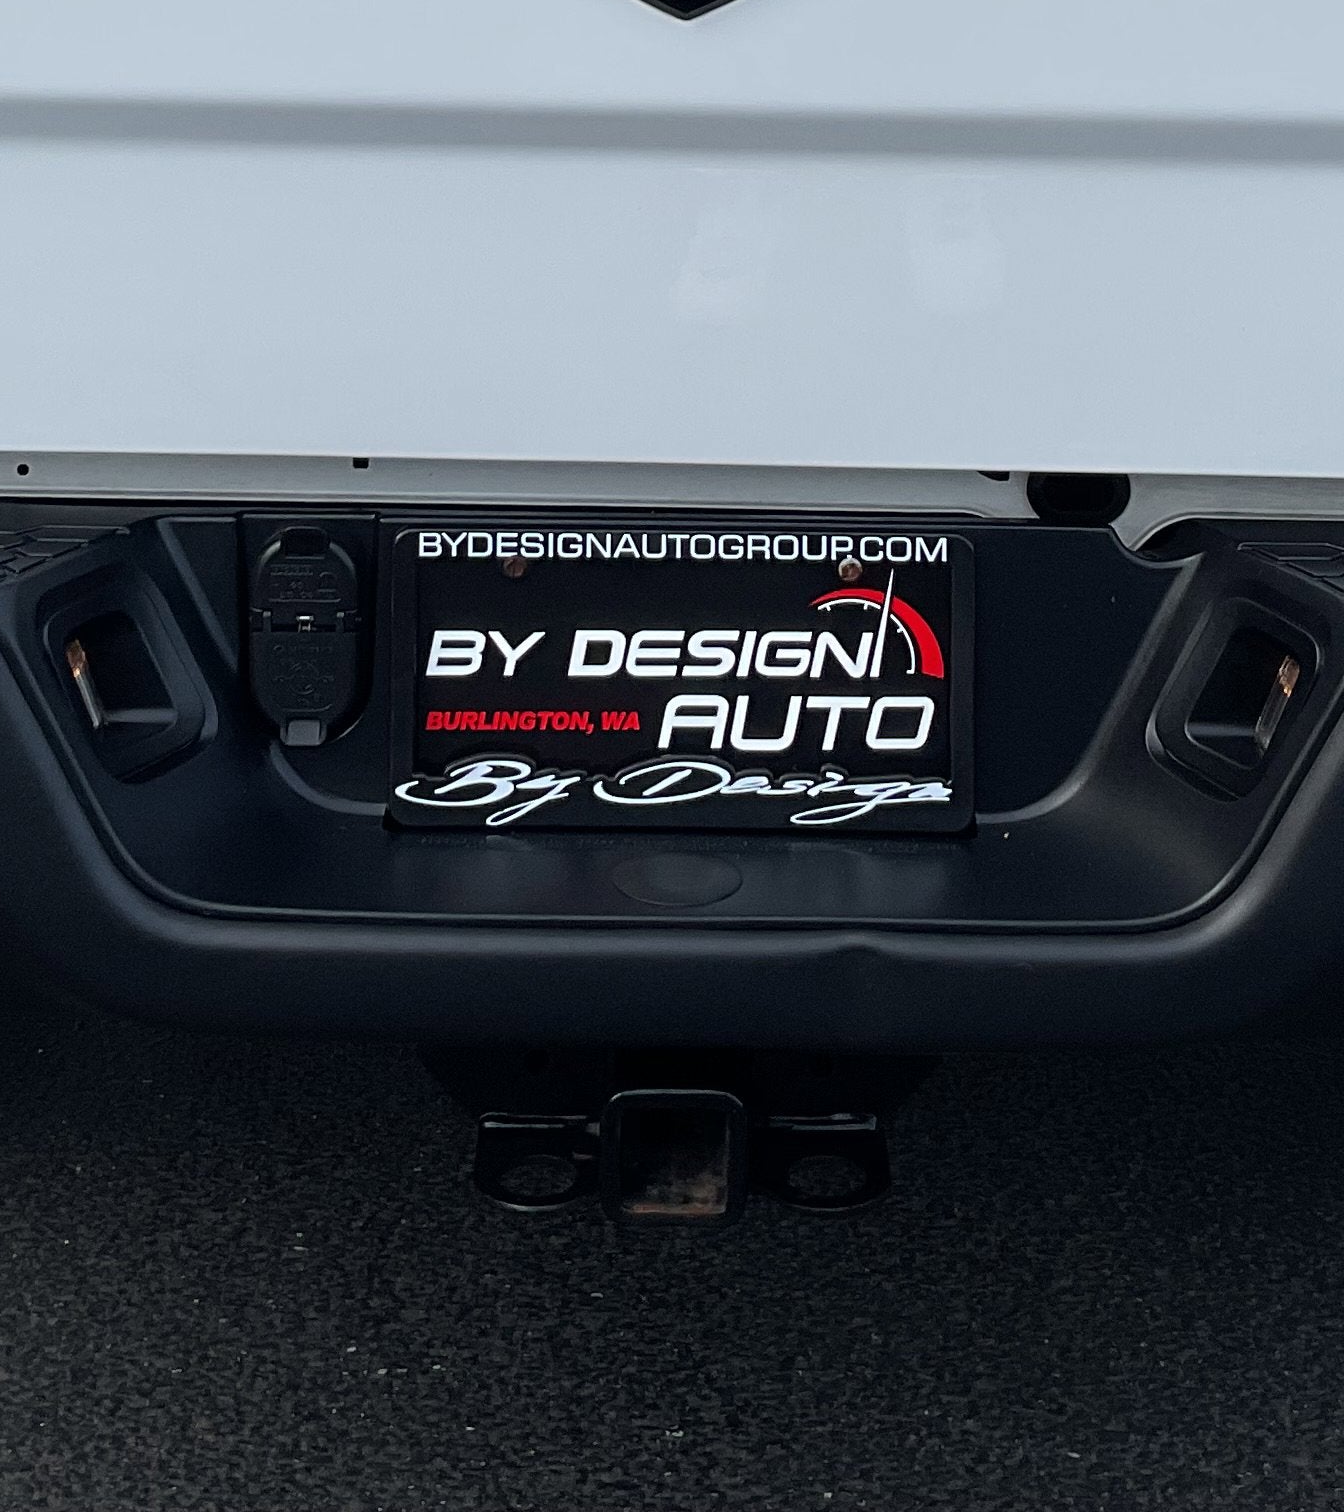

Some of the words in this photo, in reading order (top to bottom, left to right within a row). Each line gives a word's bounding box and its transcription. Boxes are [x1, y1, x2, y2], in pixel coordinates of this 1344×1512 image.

[418, 531, 949, 563] BYDESIGNAUTOGROUP.COM
[425, 630, 545, 677] BY
[567, 630, 875, 679] DESIGN
[425, 711, 594, 735] BURLINGTON,
[600, 711, 640, 731] WA
[658, 694, 936, 751] AUTO
[395, 760, 581, 826] By
[593, 761, 953, 825] Design
